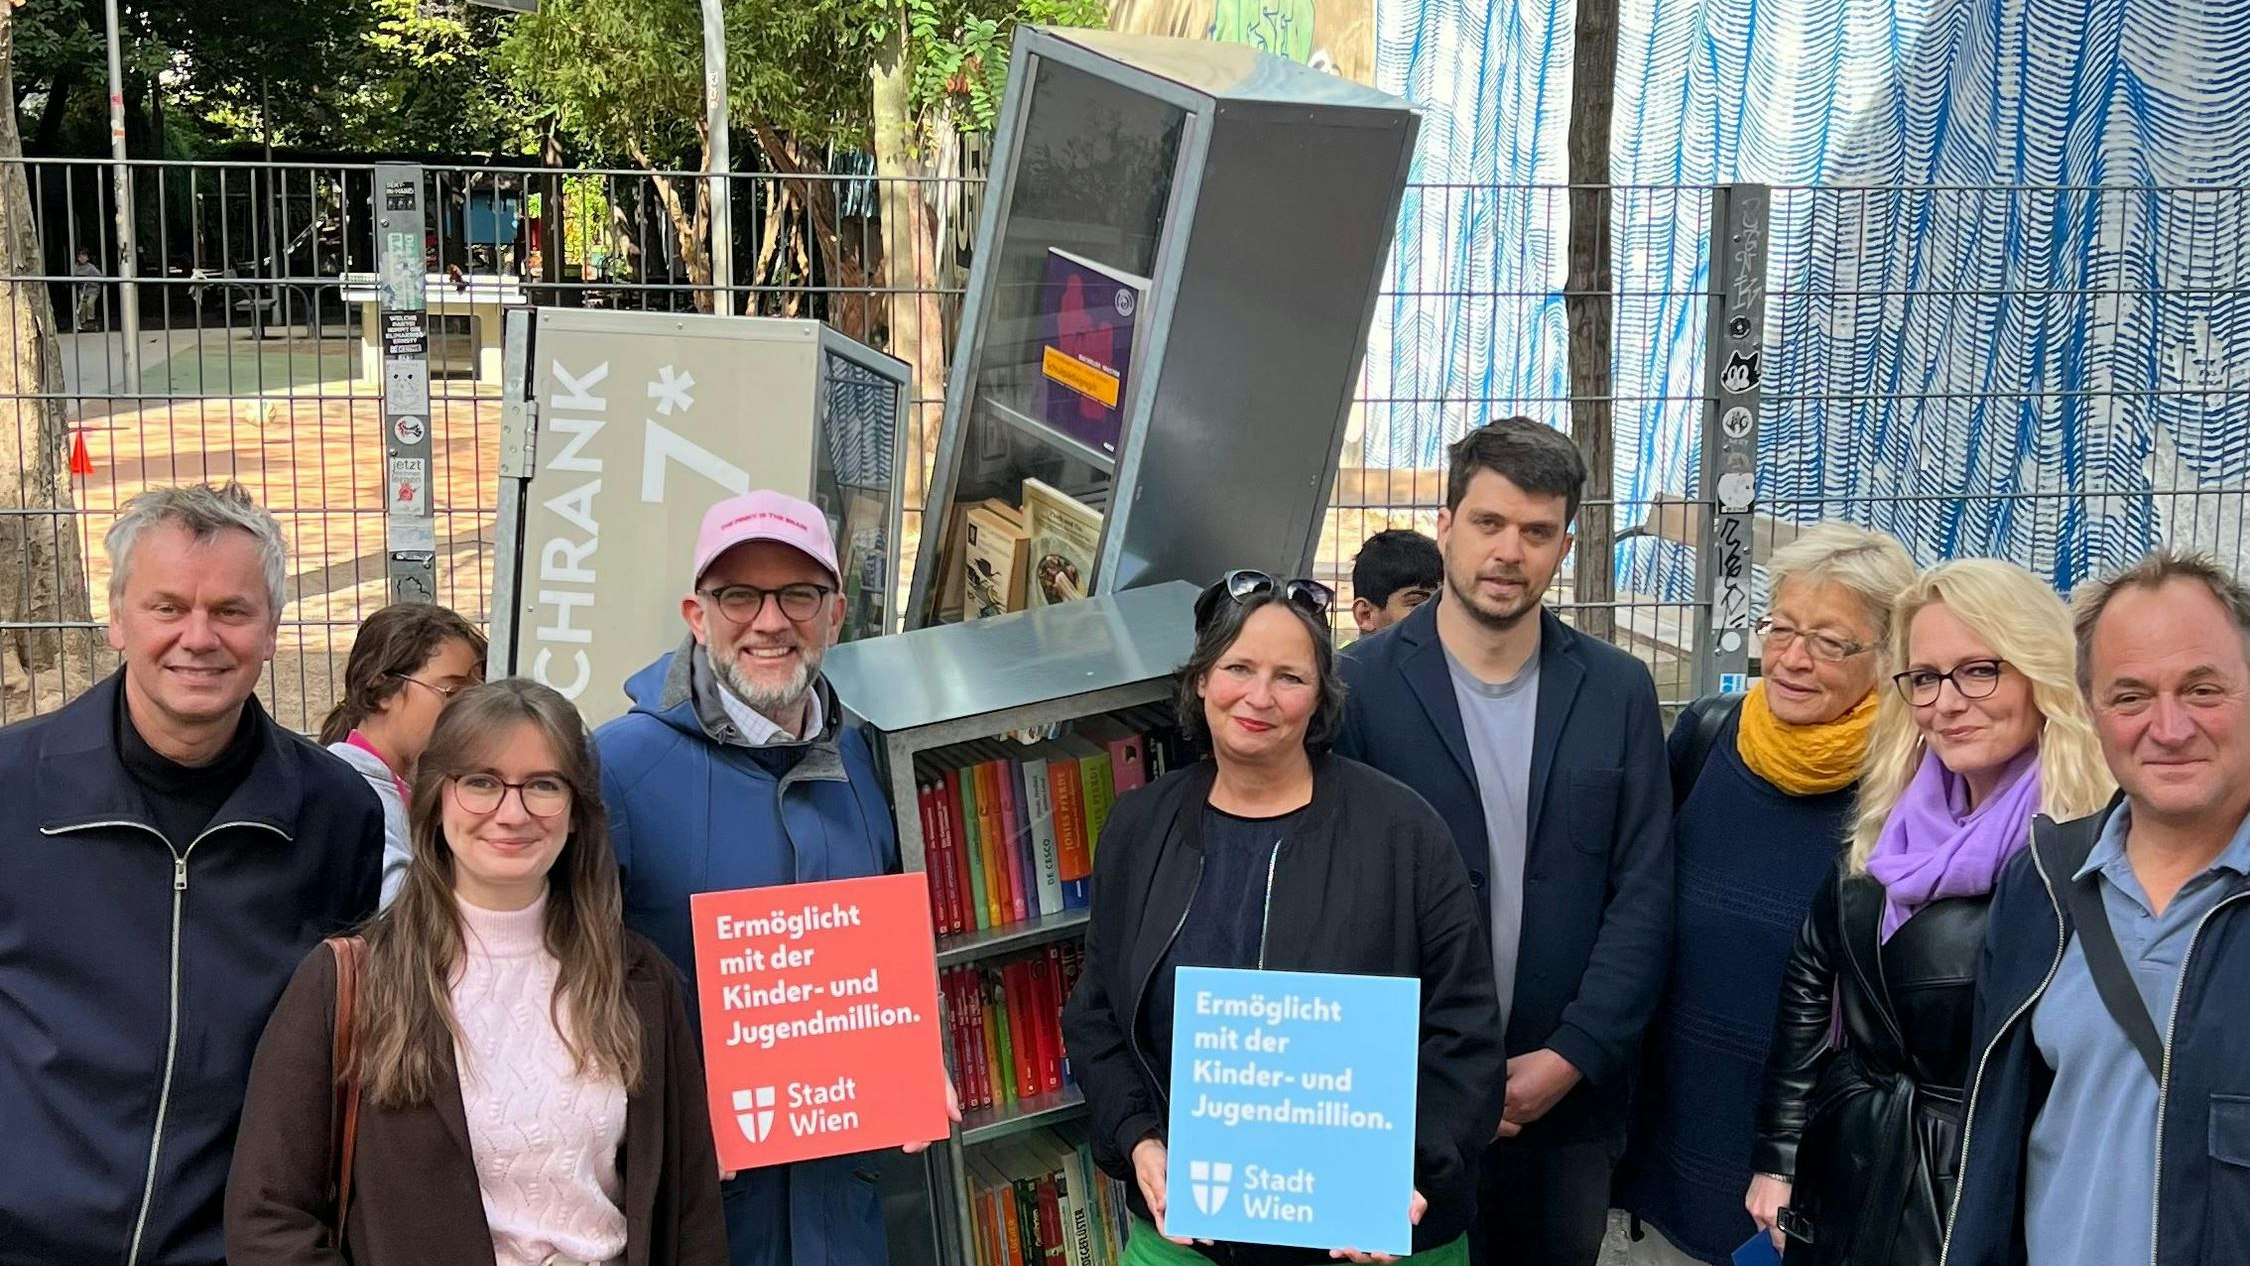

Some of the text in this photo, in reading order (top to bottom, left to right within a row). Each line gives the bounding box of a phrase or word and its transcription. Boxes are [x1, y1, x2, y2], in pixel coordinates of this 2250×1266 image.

[392, 457, 422, 473] jetzt
[533, 359, 608, 700] CHRANK
[1056, 772, 1074, 851] JOSIES PFERDE
[1042, 838, 1055, 886] DE CESCO
[716, 903, 861, 940] Ermöglicht
[720, 944, 815, 976] mit der
[722, 968, 879, 1011] Kinder- und
[1196, 991, 1343, 1025] Ermöglicht
[725, 1003, 921, 1049] Jugendmillion.
[1194, 1026, 1290, 1053] mit der
[787, 1076, 856, 1108] Stadt
[1193, 1059, 1353, 1092] Kinder- und
[788, 1108, 859, 1137] Wien
[1191, 1094, 1393, 1130] Jugendmillion.
[1243, 1163, 1316, 1195] Stadt
[1243, 1194, 1314, 1223] Wien
[1074, 1207, 1091, 1266] DEGEFLÜSTER
